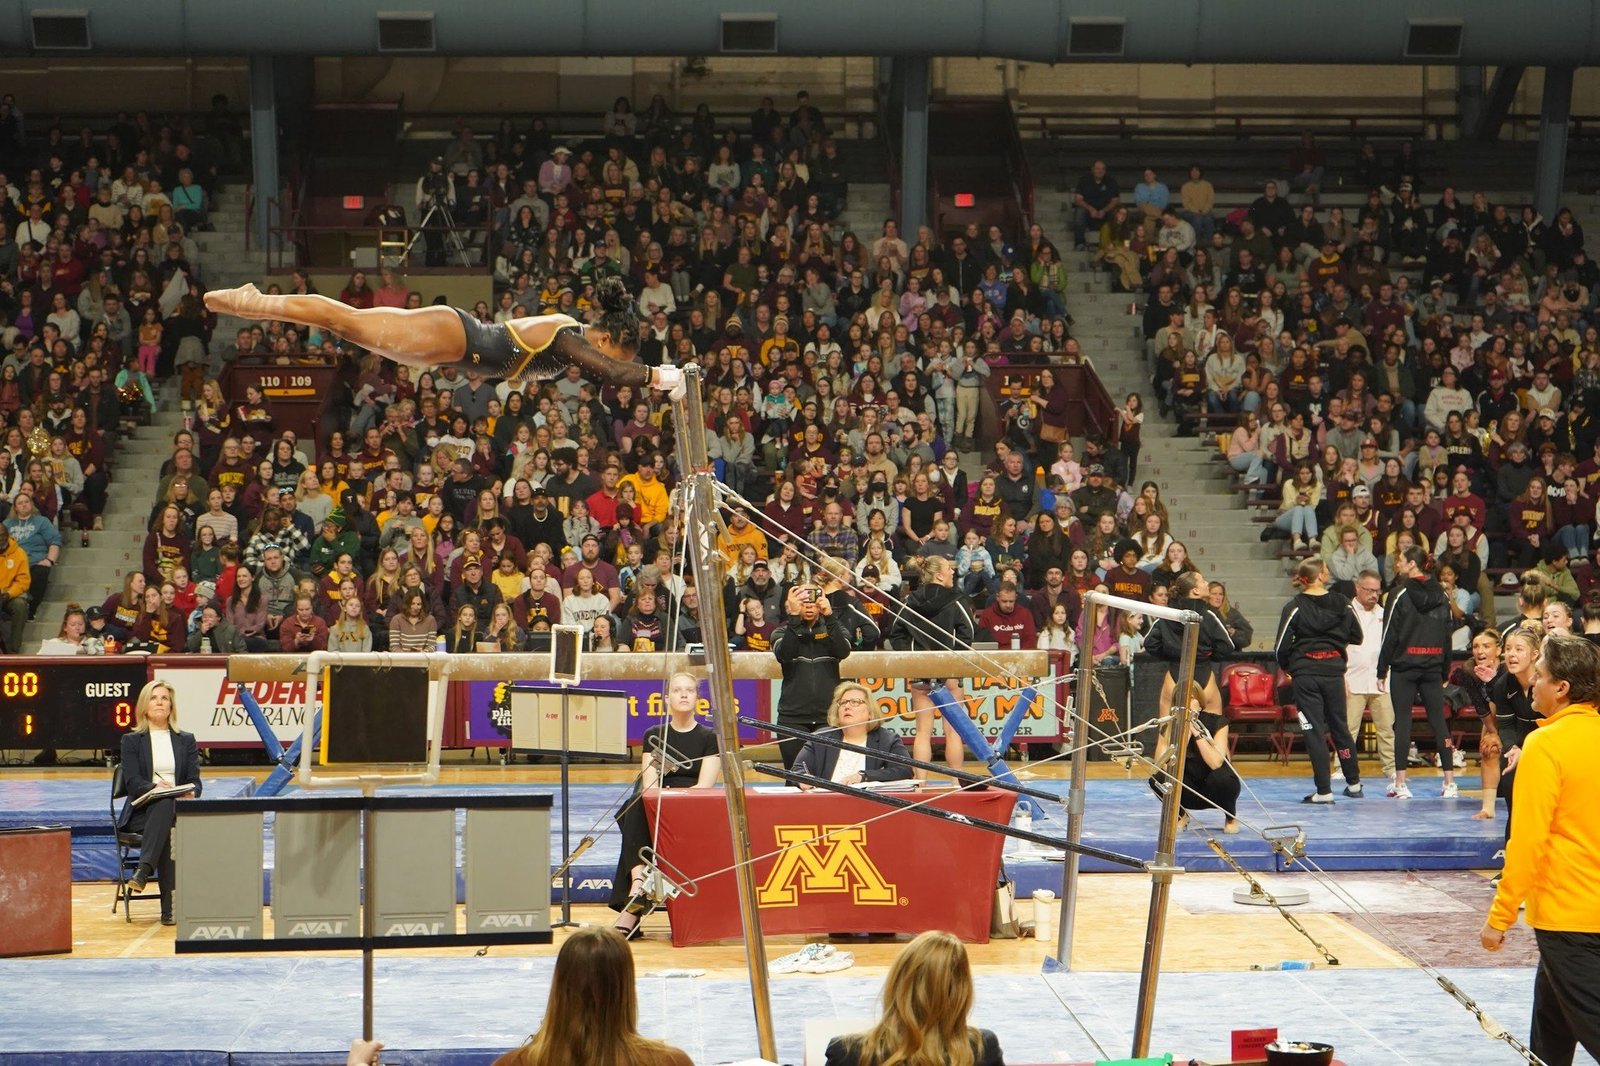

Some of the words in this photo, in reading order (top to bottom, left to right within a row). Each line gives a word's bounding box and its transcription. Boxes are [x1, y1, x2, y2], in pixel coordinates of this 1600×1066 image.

[260, 377, 280, 387] 110
[291, 376, 312, 387] 109
[4, 672, 38, 697] 00
[85, 683, 131, 697] GUEST
[26, 714, 32, 735] 1
[115, 702, 131, 727] 0
[756, 824, 897, 908] M
